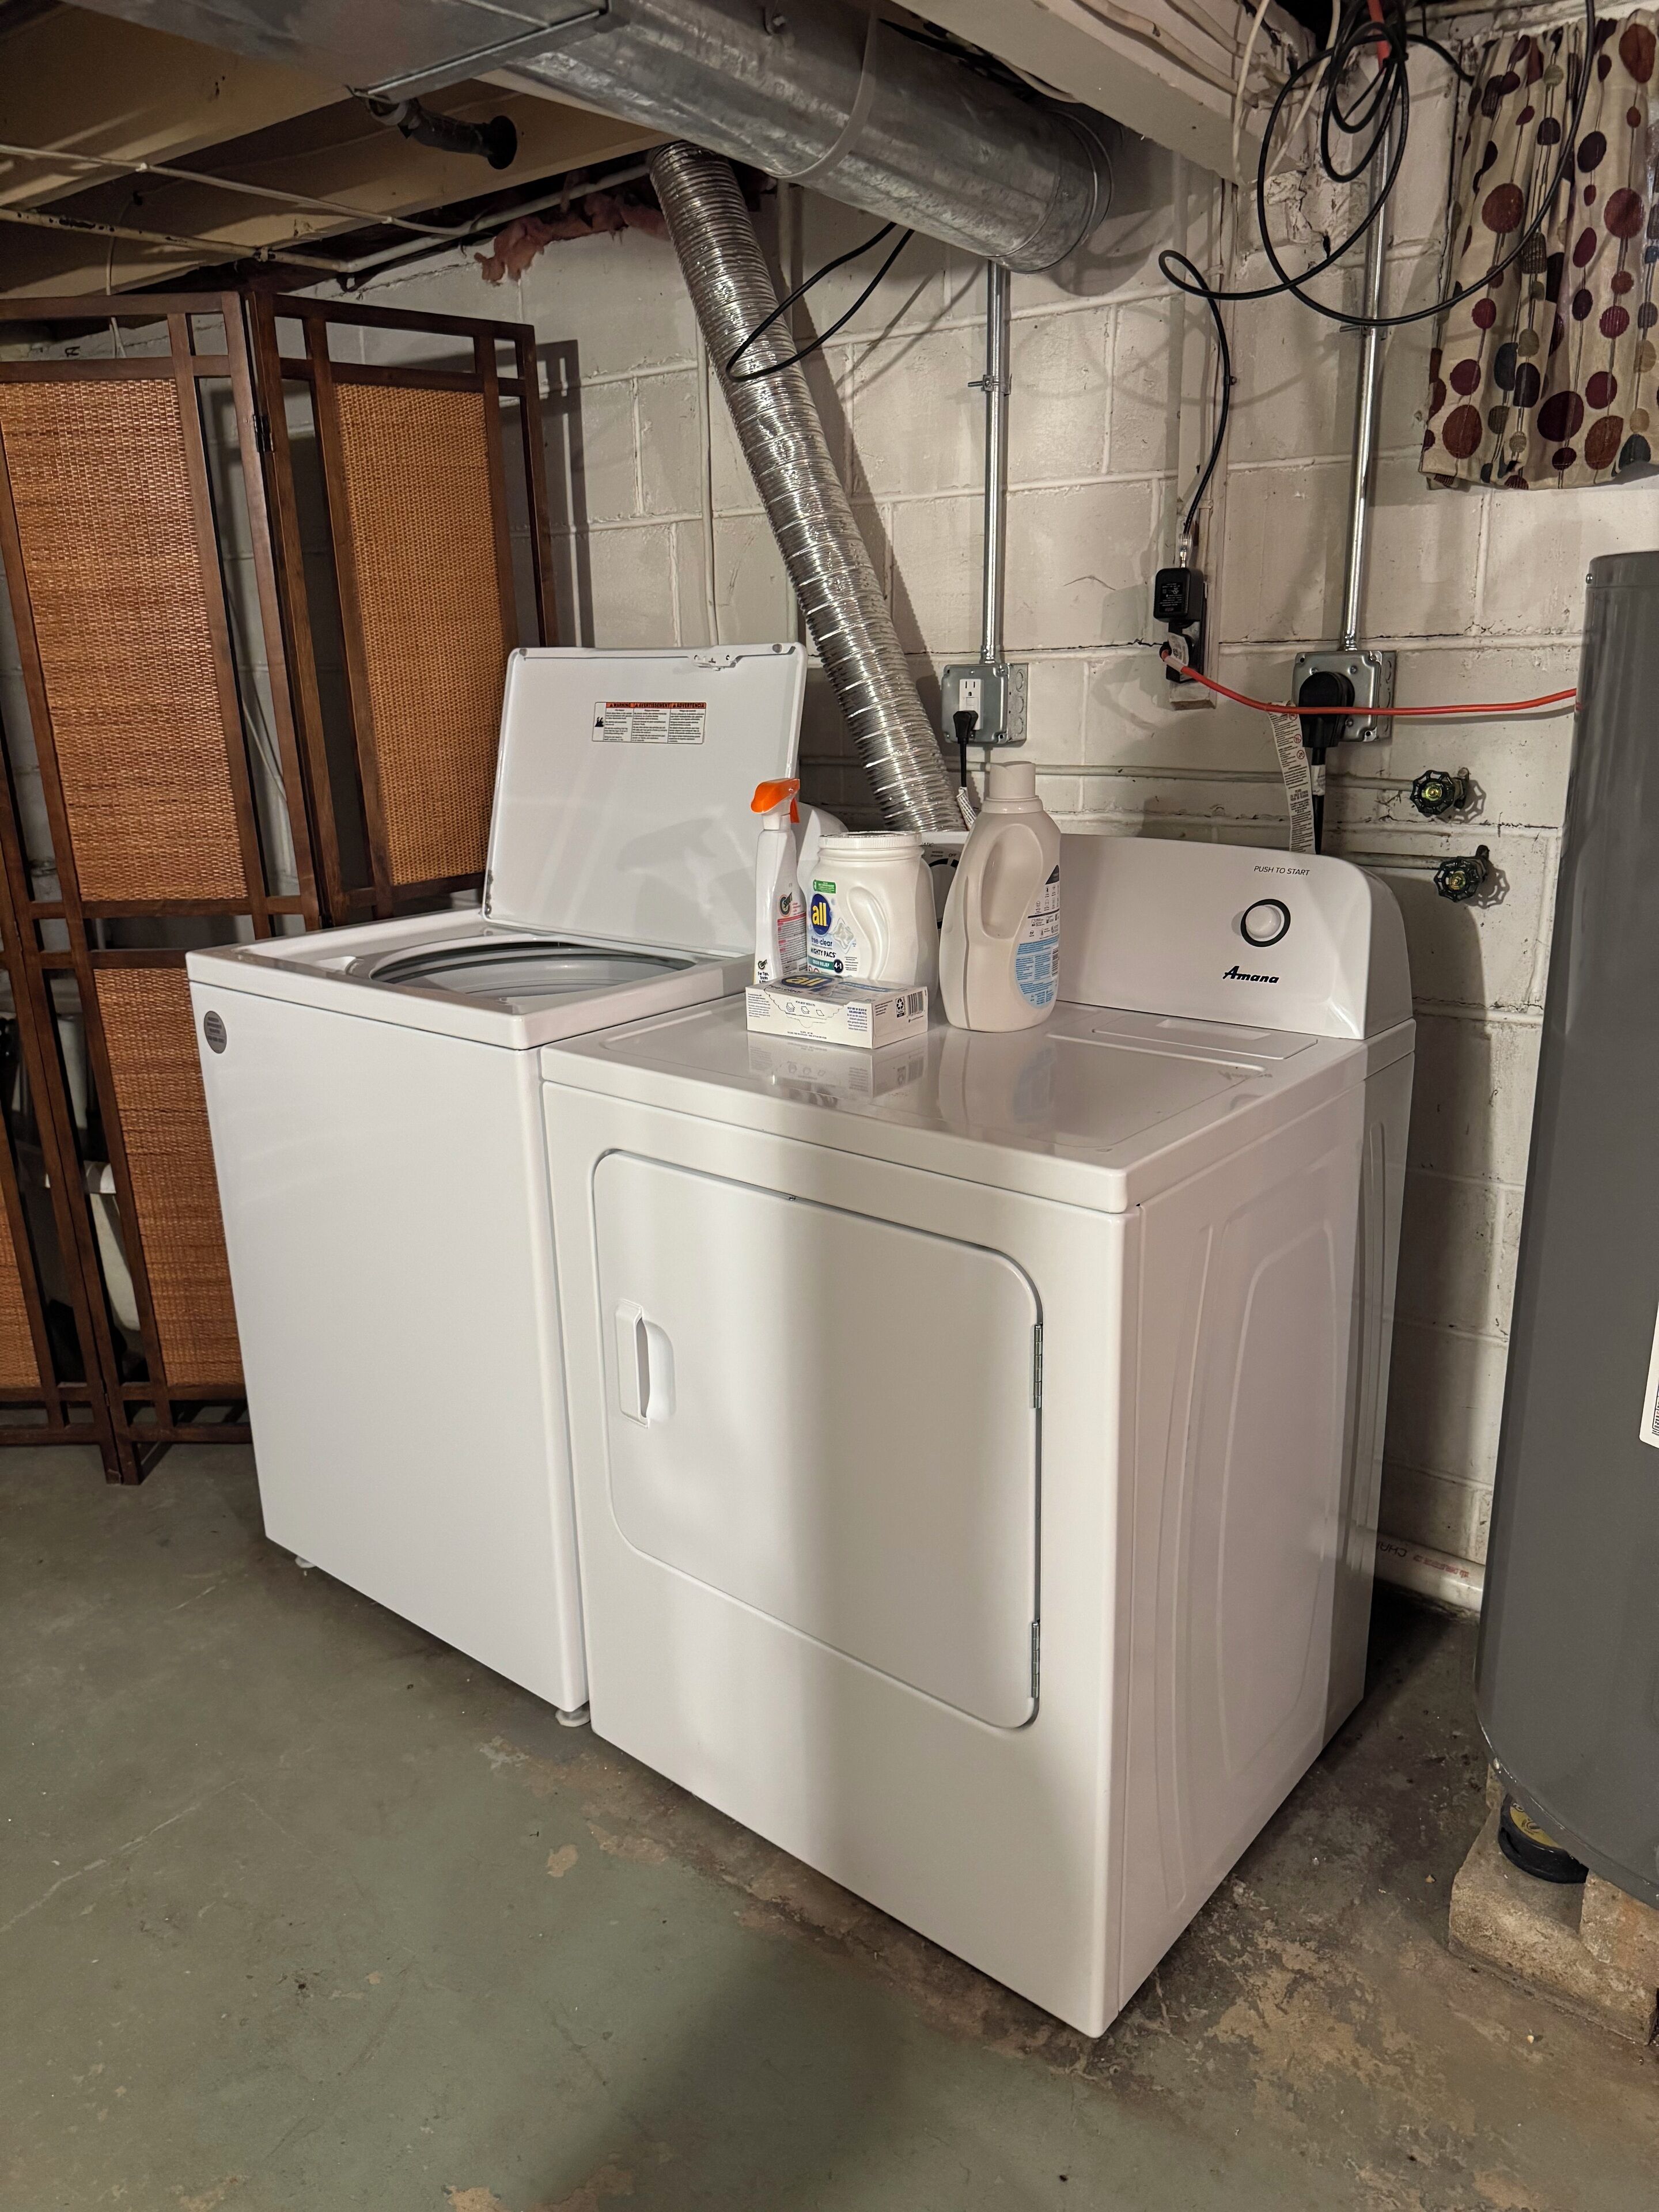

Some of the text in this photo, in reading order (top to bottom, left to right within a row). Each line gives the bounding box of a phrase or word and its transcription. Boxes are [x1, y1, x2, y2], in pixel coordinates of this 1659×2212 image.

[1253, 865, 1274, 873] PUSH
[812, 902, 827, 926] all
[820, 938, 833, 947] clear
[811, 948, 823, 956] MIGHTY
[1222, 965, 1279, 984] Amana
[786, 976, 823, 987] all
